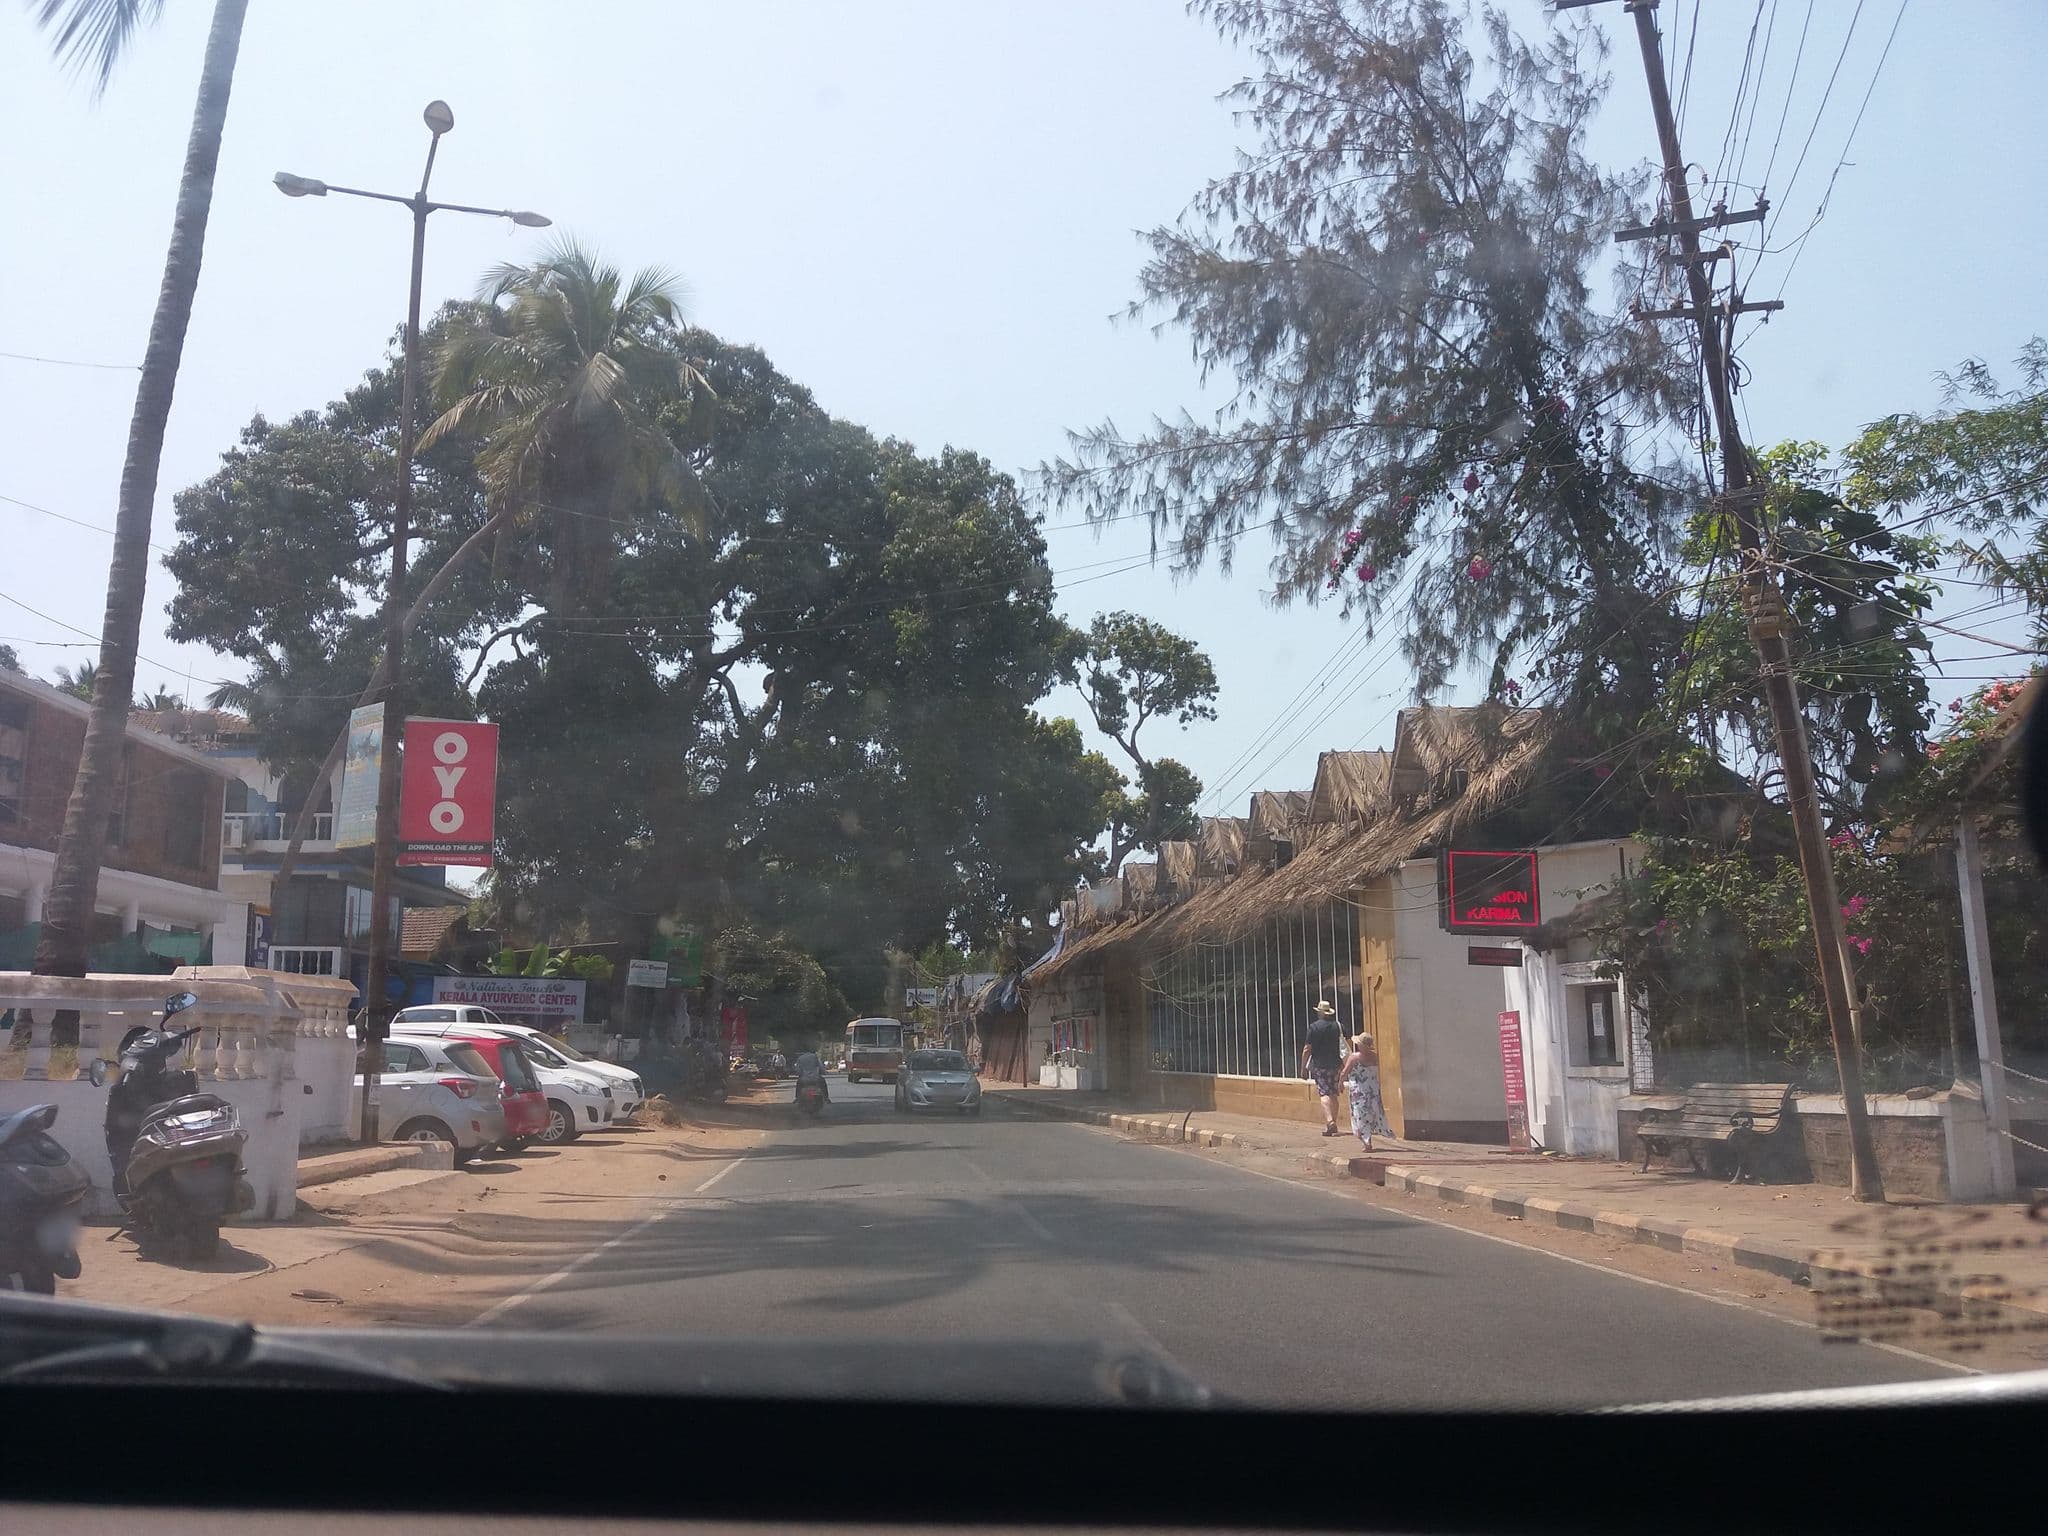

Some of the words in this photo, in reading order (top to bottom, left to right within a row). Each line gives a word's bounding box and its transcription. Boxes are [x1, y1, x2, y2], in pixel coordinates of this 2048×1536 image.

[429, 732, 468, 834] OYO
[408, 844, 451, 852] DOWNLOAD
[452, 844, 467, 852] THE
[468, 844, 484, 852] APP
[1466, 906, 1522, 920] KARMA
[439, 991, 478, 1003] KERALA
[480, 992, 536, 1004] AYURVEDIC
[539, 994, 577, 1006] CENTER
